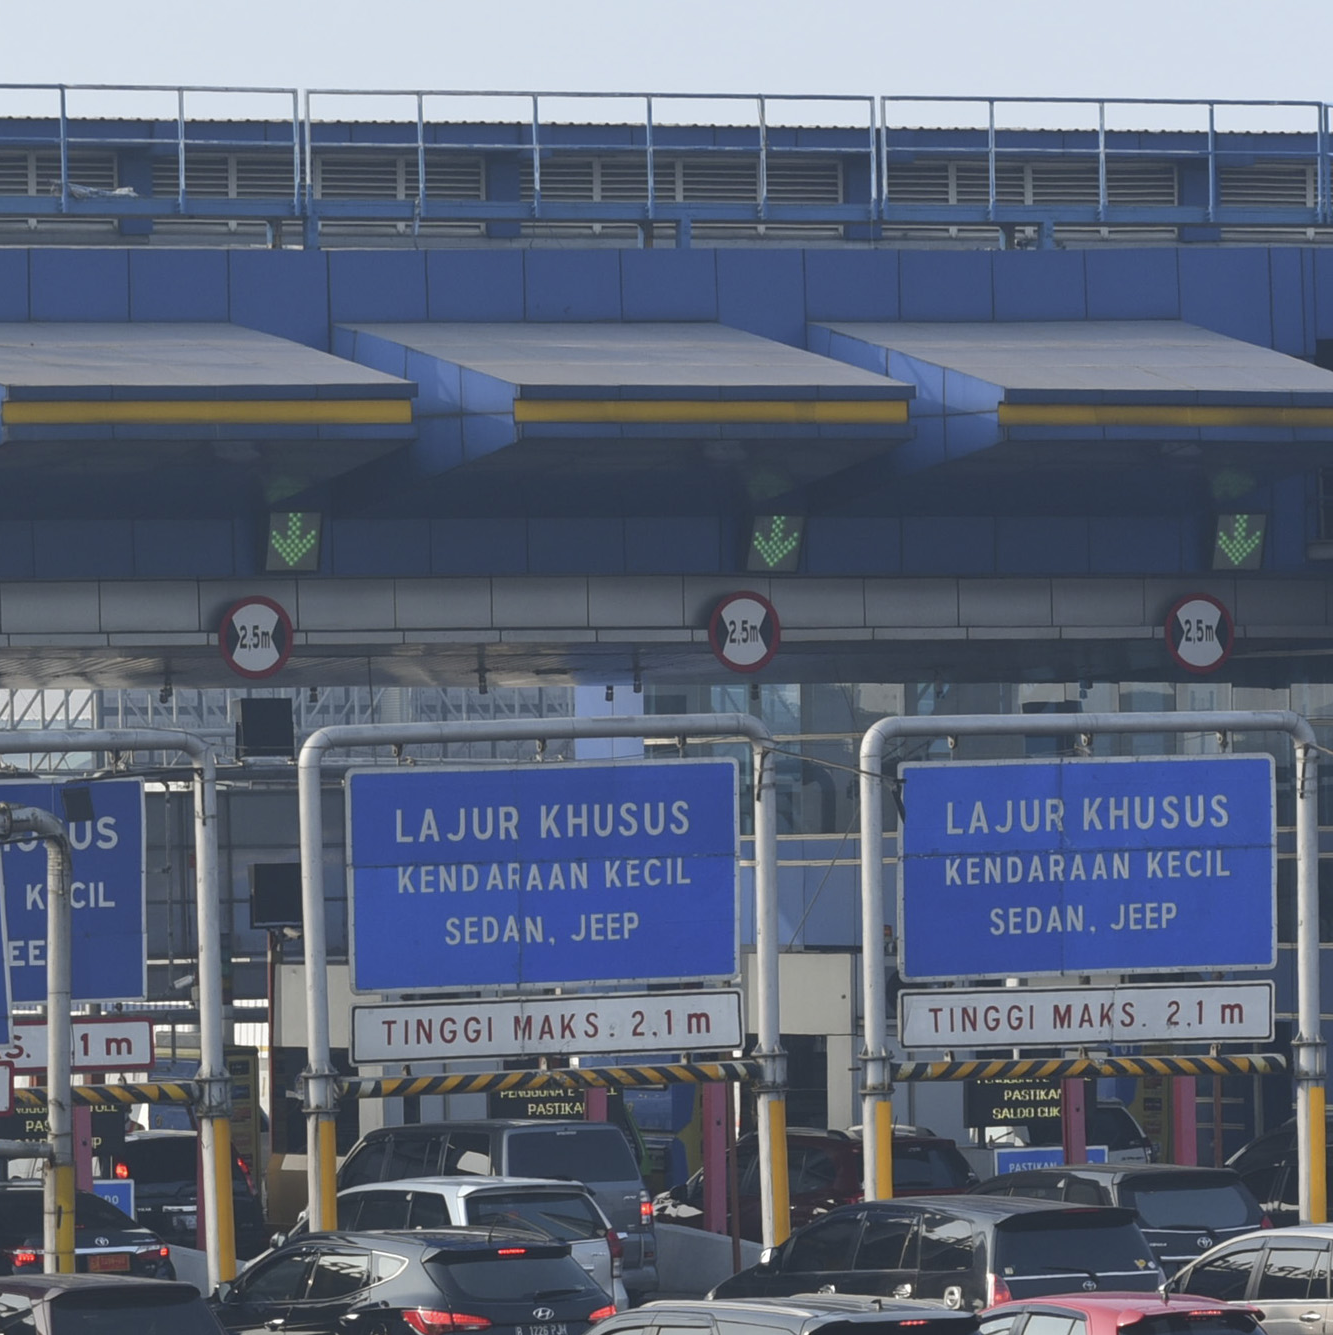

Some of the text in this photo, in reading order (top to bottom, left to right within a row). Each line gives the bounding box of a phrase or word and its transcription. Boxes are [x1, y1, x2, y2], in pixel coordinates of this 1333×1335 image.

[396, 800, 690, 843] LAJUR KHUSUS
[946, 795, 1229, 835] LAJUR KHUSUS
[397, 857, 692, 894] KENDARAAN KECIL
[945, 849, 1231, 886] KENDARAAN KECIL
[26, 881, 115, 910] KCIL
[445, 912, 640, 946] SEDAN, JEEP
[1110, 902, 1177, 931] JEEP
[382, 1016, 493, 1046] TINGGI
[687, 1011, 711, 1034] m
[928, 1004, 1034, 1033] TINGGI
[1052, 1002, 1147, 1029] MAKS.
[1220, 1002, 1244, 1025] m
[527, 1102, 585, 1116] PASTIKA
[992, 1106, 1061, 1120] SALDO CUK
